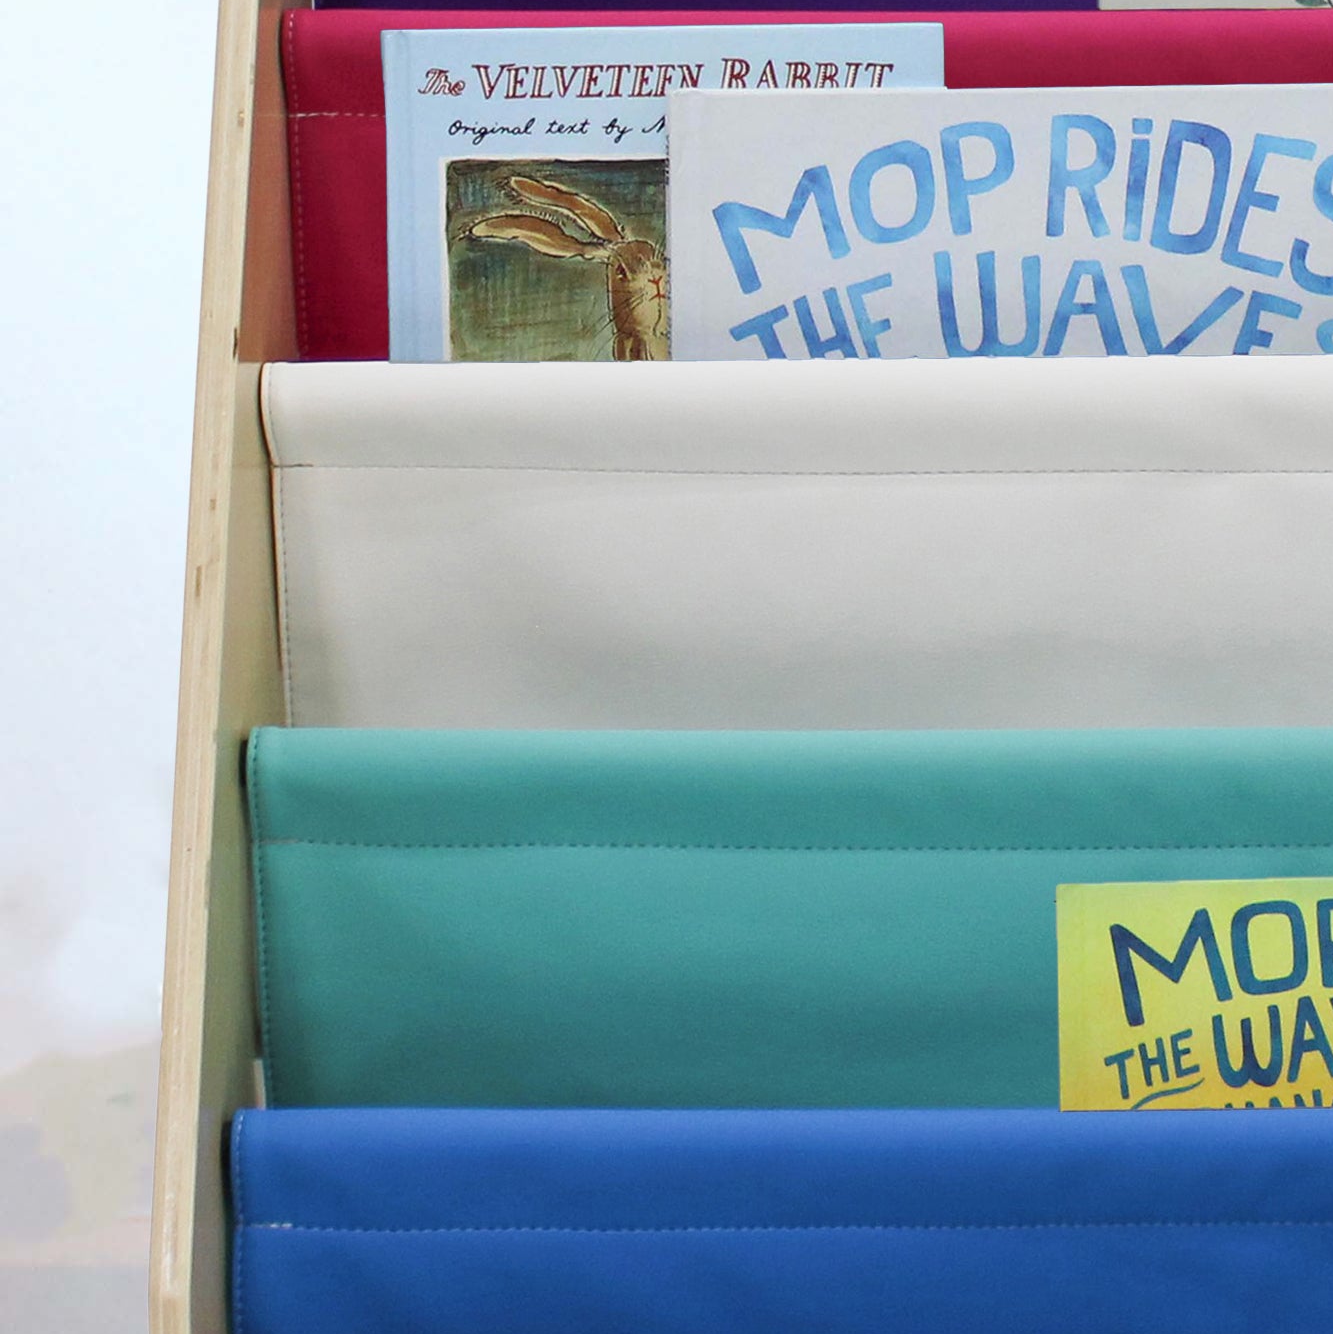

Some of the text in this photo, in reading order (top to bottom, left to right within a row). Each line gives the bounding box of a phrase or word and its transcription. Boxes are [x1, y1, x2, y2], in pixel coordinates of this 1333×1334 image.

[417, 57, 895, 100] The VELVETEEN RABBIT
[447, 117, 536, 146] Original
[545, 120, 590, 136] text
[601, 118, 633, 144] by
[713, 121, 1015, 295] MOP
[729, 273, 893, 358] THE
[1103, 1028, 1200, 1100] THE
